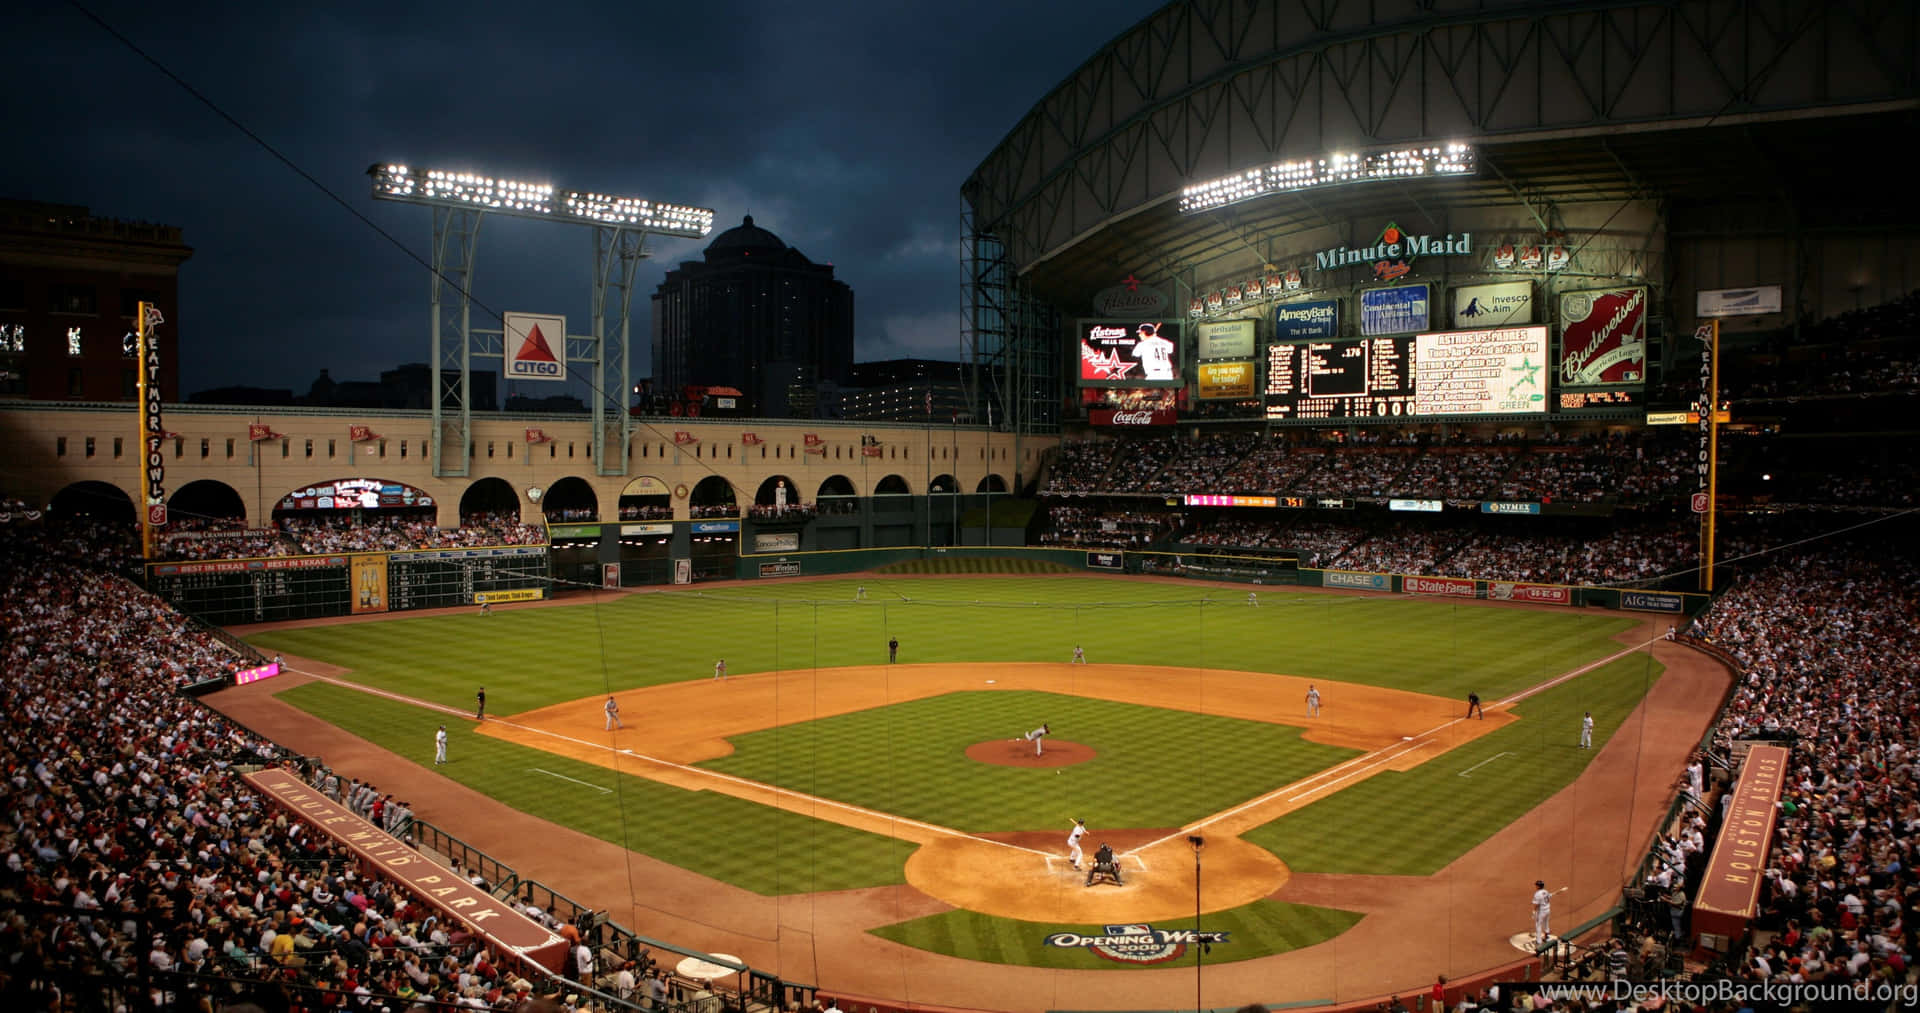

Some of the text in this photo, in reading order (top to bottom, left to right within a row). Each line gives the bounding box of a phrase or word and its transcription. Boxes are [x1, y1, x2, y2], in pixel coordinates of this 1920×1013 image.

[1315, 232, 1472, 271] Minute Maid
[1497, 244, 1512, 259] 19
[1521, 246, 1539, 260] 24
[1553, 246, 1562, 260] 5
[1374, 260, 1412, 280] Park
[1492, 294, 1528, 303] Invesco
[1364, 301, 1410, 313] Continental
[1493, 305, 1511, 313] Aim
[1090, 325, 1126, 340] Astros
[1560, 288, 1645, 380] Budweiser
[1524, 342, 1538, 352] PM
[514, 361, 558, 375] CITGO
[1208, 365, 1245, 377] Are you ready
[1220, 374, 1241, 384] today?
[1377, 402, 1386, 416] 0
[1391, 402, 1401, 416] 0
[1406, 402, 1415, 416] 0
[1499, 400, 1530, 409] GREEN
[148, 338, 162, 496] EAT MOR FOWL
[1698, 351, 1710, 488] EAT MOR FOWL
[354, 428, 364, 436] 97
[334, 479, 384, 492] Landry's
[1500, 503, 1530, 512] NYMEX
[203, 530, 241, 538] CRAWFORD
[180, 565, 204, 573] BEST
[215, 563, 244, 571] TEXAS
[267, 560, 288, 568] BEST
[289, 559, 298, 567] IN
[299, 558, 326, 567] TEXAS
[1329, 574, 1371, 585] CHASE
[1419, 580, 1472, 594] State Farm
[1624, 595, 1643, 607] AIG
[1725, 810, 1766, 884] HOUSTON
[1751, 759, 1777, 801] ASTROS
[270, 781, 346, 825] MINUTE
[347, 832, 411, 867] MAID
[416, 875, 500, 922] PARK
[1118, 944, 1156, 952] 2008
